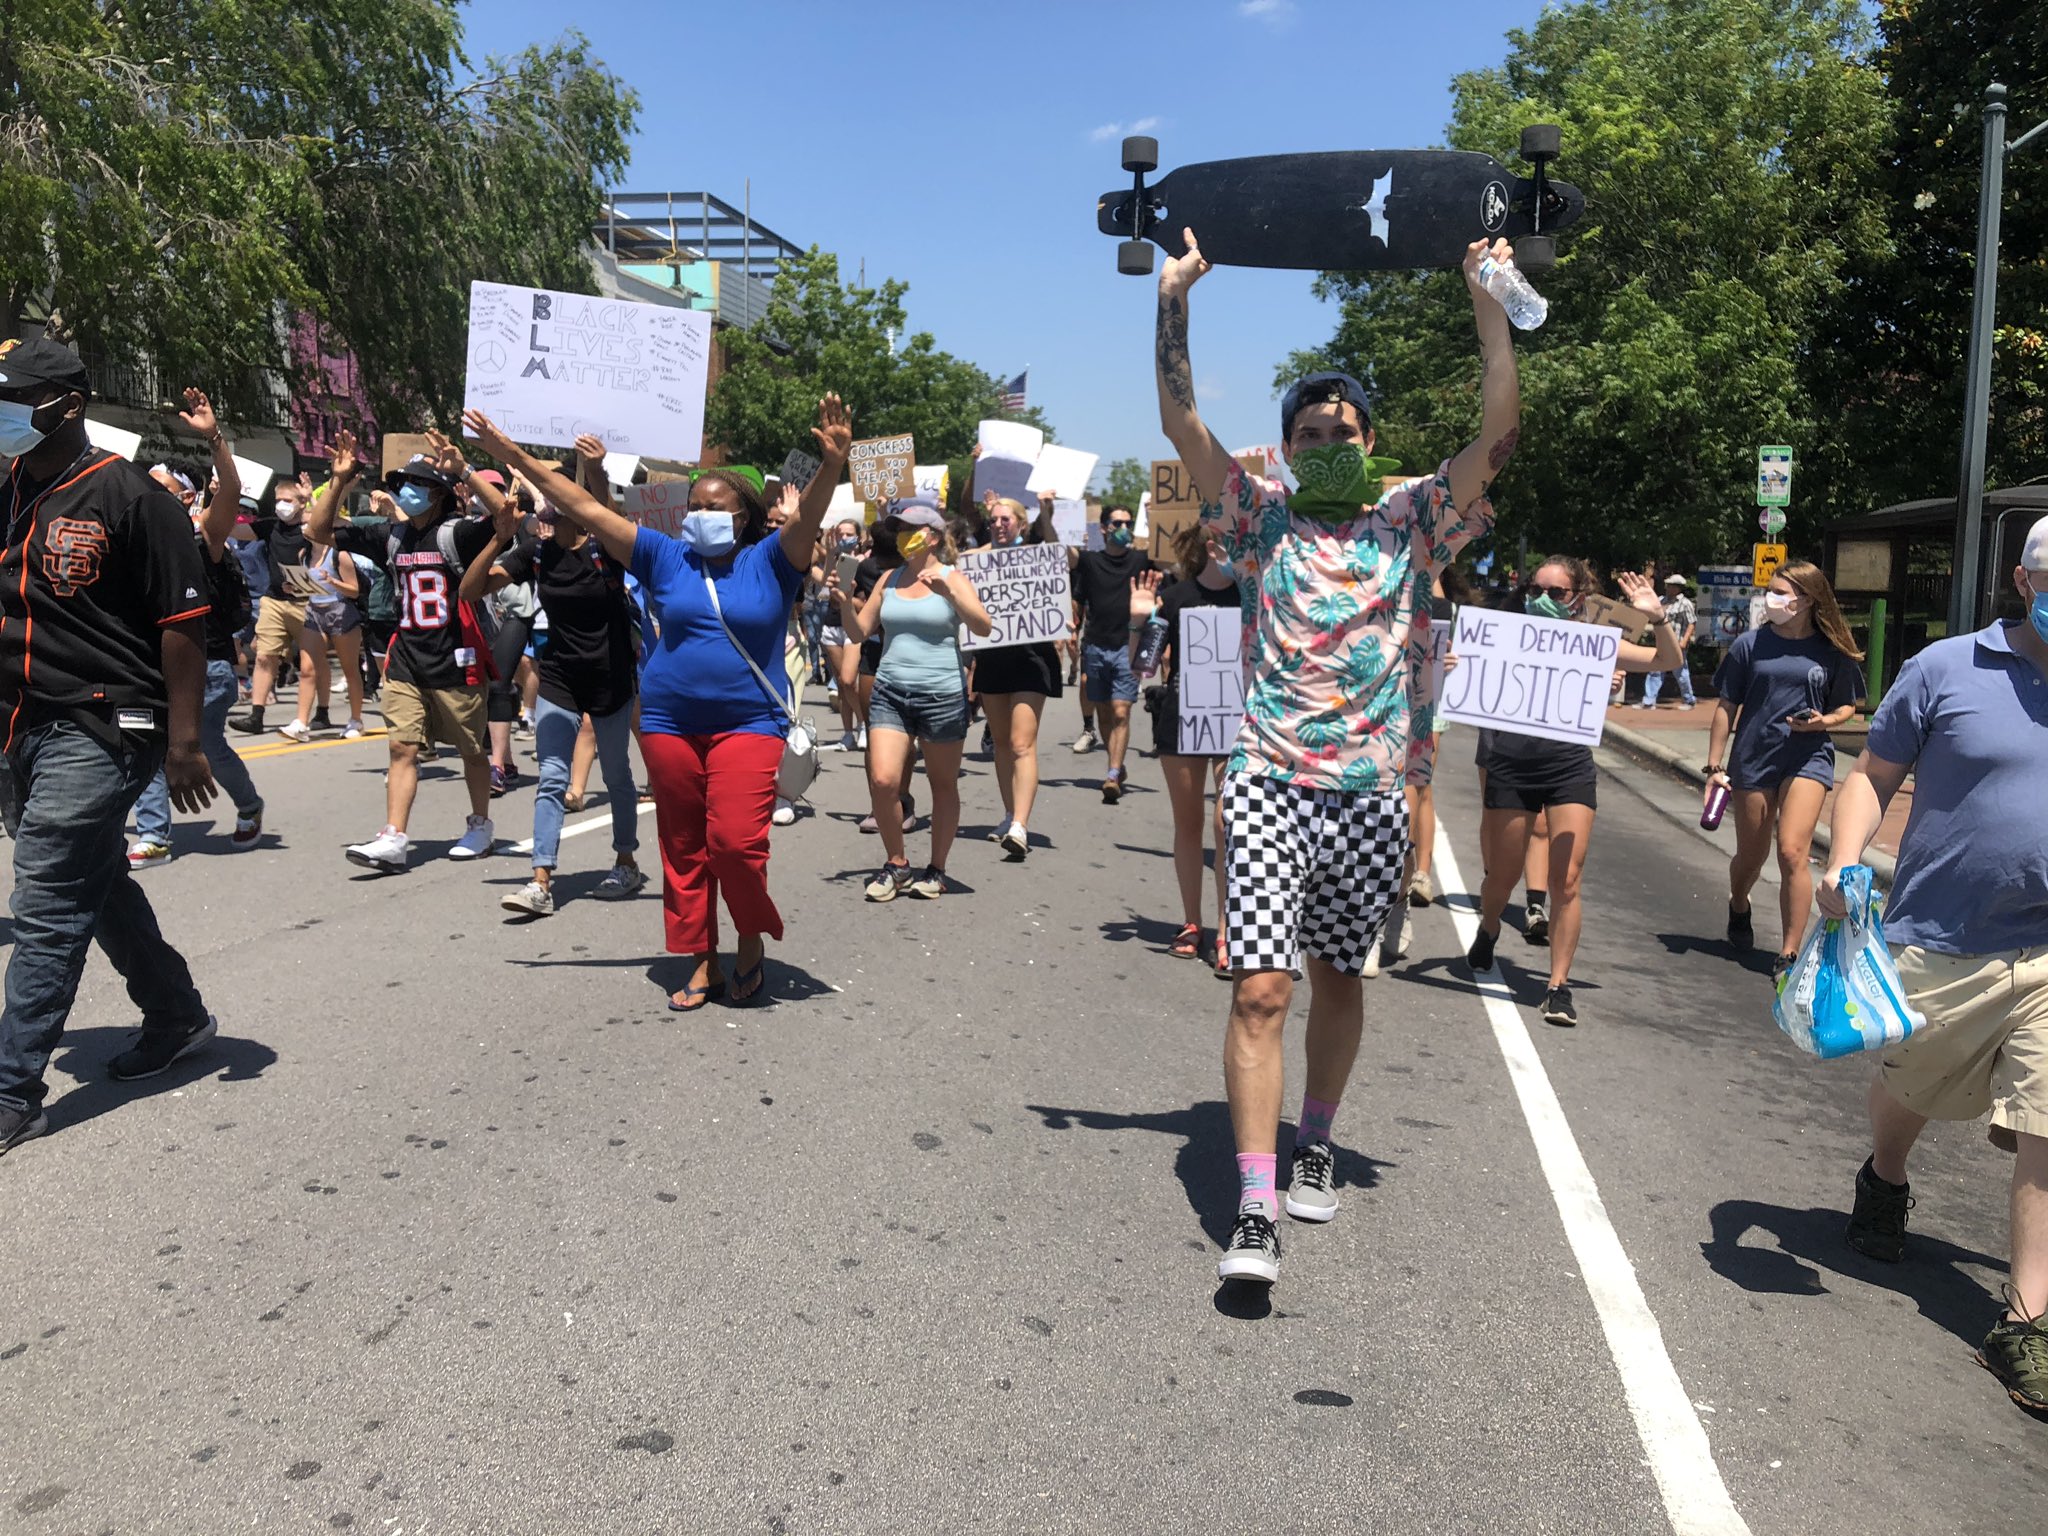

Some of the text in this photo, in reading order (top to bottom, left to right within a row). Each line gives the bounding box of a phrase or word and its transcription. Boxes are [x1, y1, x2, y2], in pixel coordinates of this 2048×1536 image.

[533, 293, 638, 334] BLACK
[530, 324, 643, 365] LIVES
[520, 356, 651, 393] MATTER
[850, 440, 914, 460] CONGRESS
[853, 458, 907, 472] CAN YOU
[857, 469, 903, 484] HEAR
[640, 483, 668, 506] NO
[960, 544, 1067, 571] I UNDERSTAND
[978, 577, 1067, 603] DERSTAND
[1733, 575, 1740, 584] &
[400, 570, 450, 630] 18
[984, 596, 1059, 615] OWEVER,
[990, 608, 1065, 643] STAND
[1188, 614, 1242, 665] BL
[1460, 617, 1499, 647] WE
[1520, 623, 1617, 662] DEMAND
[1446, 655, 1604, 732] JUSTICE
